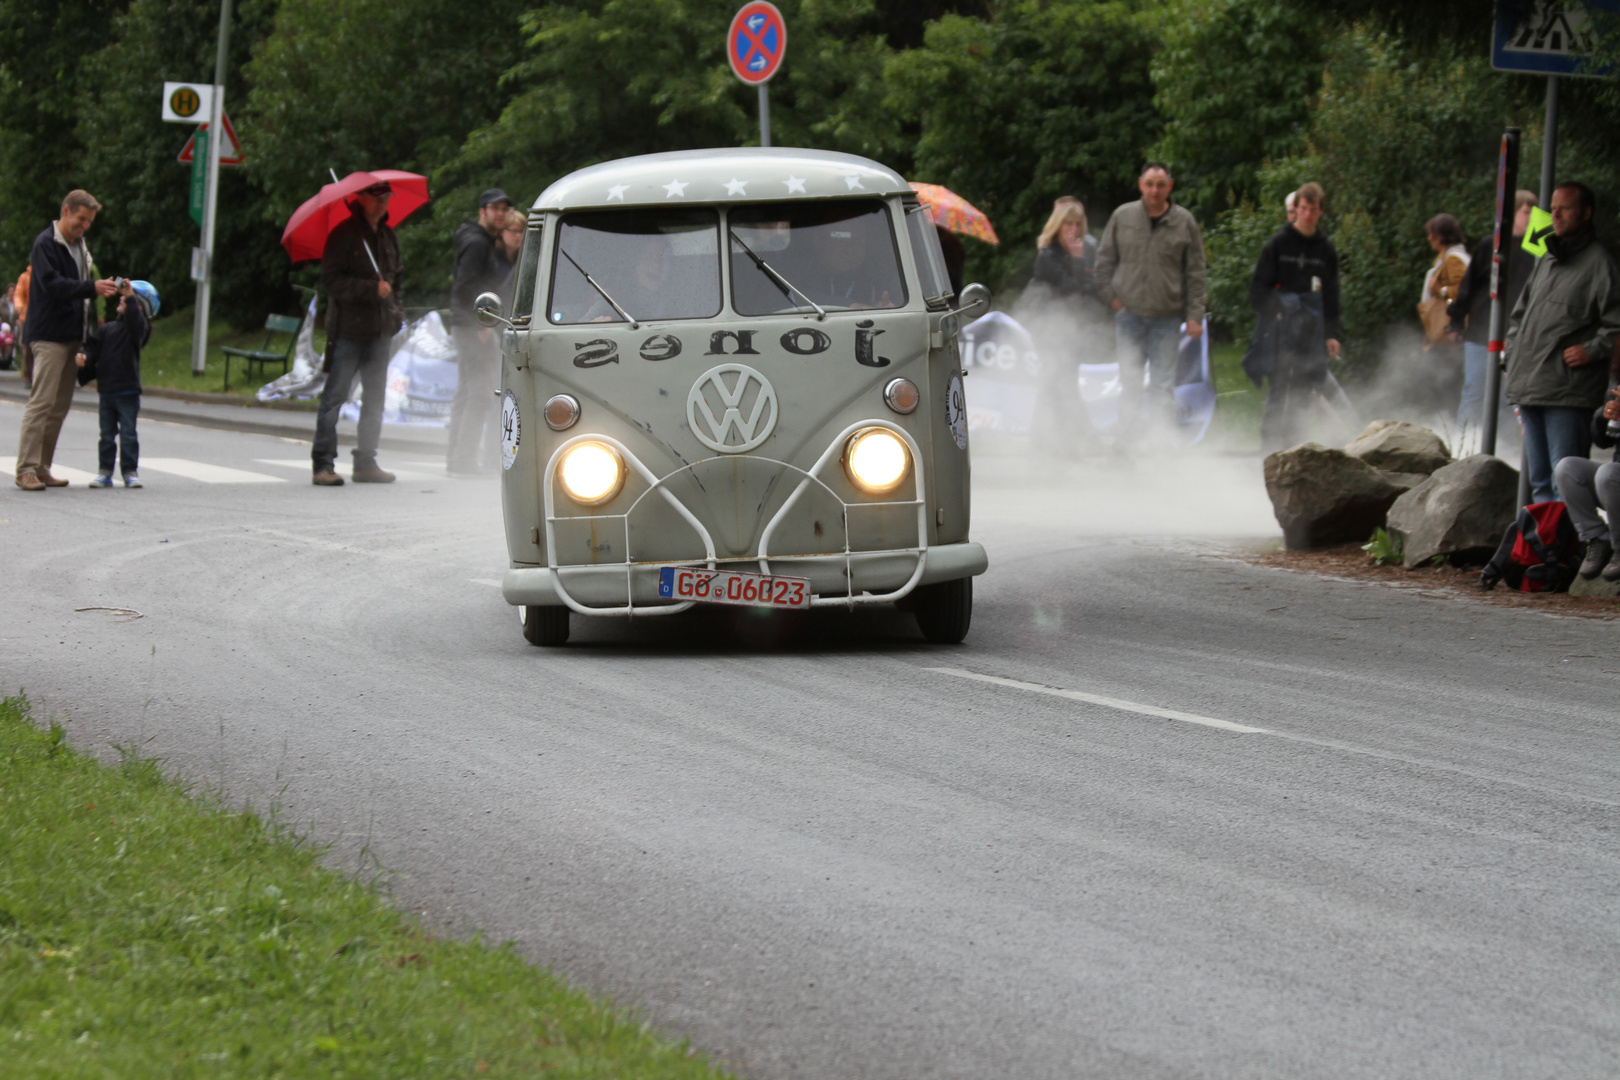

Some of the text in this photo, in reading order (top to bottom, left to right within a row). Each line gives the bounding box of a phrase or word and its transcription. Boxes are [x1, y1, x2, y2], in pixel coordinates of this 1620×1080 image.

[177, 92, 193, 112] H
[501, 406, 516, 443] 94
[689, 365, 776, 452] VW
[663, 585, 669, 593] D
[678, 572, 806, 606] GÖ 06023
